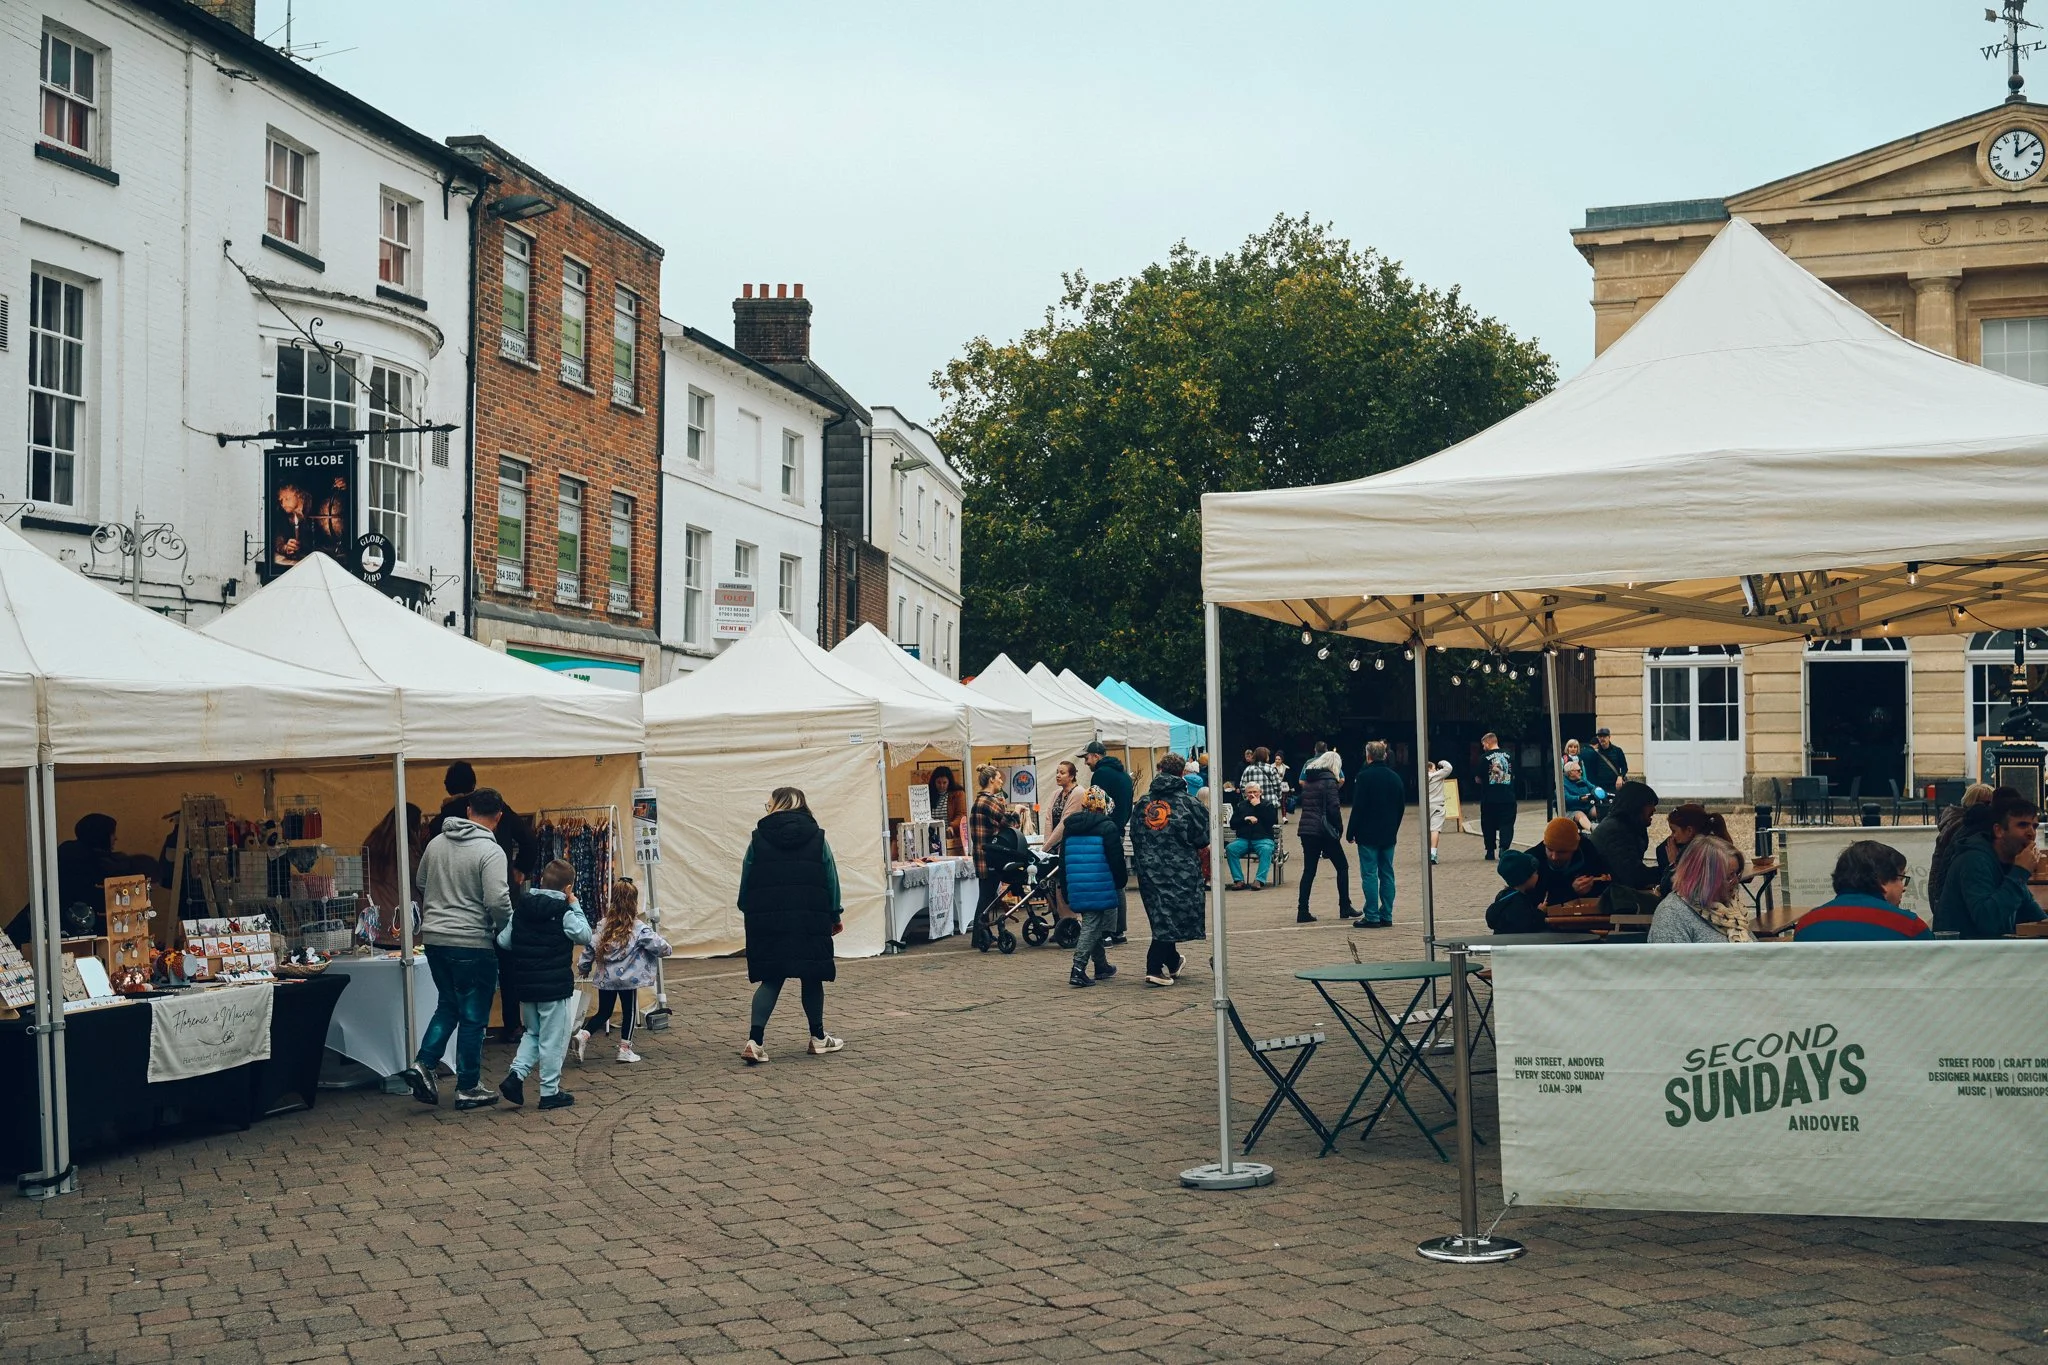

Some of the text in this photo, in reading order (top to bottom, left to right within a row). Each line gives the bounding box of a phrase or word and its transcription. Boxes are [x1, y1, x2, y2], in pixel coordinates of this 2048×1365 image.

[1980, 43, 2002, 61] W
[278, 454, 344, 467] THE GLOBE
[360, 534, 385, 546] GLOBE
[364, 572, 382, 582] YARD
[505, 570, 521, 582] 363714
[172, 1009, 210, 1037] Florence
[1682, 1023, 1838, 1072] SECOND
[1514, 1056, 1604, 1068] HIGH STREET, ANDOVER
[1938, 1058, 1969, 1068] STREET
[1972, 1058, 1995, 1068] FOOD
[2004, 1058, 2032, 1068] CRAFT
[1515, 1070, 1605, 1080] EVERY SECOND SUNDAY
[1928, 1072, 1970, 1082] DESIGNER
[1973, 1072, 2008, 1082] MAKERS
[1538, 1084, 1582, 1094] 10AM-3PM
[1664, 1043, 1867, 1128] SUNDAYS
[1958, 1086, 1986, 1096] MUSIC
[1788, 1115, 1860, 1132] ANDOVER
